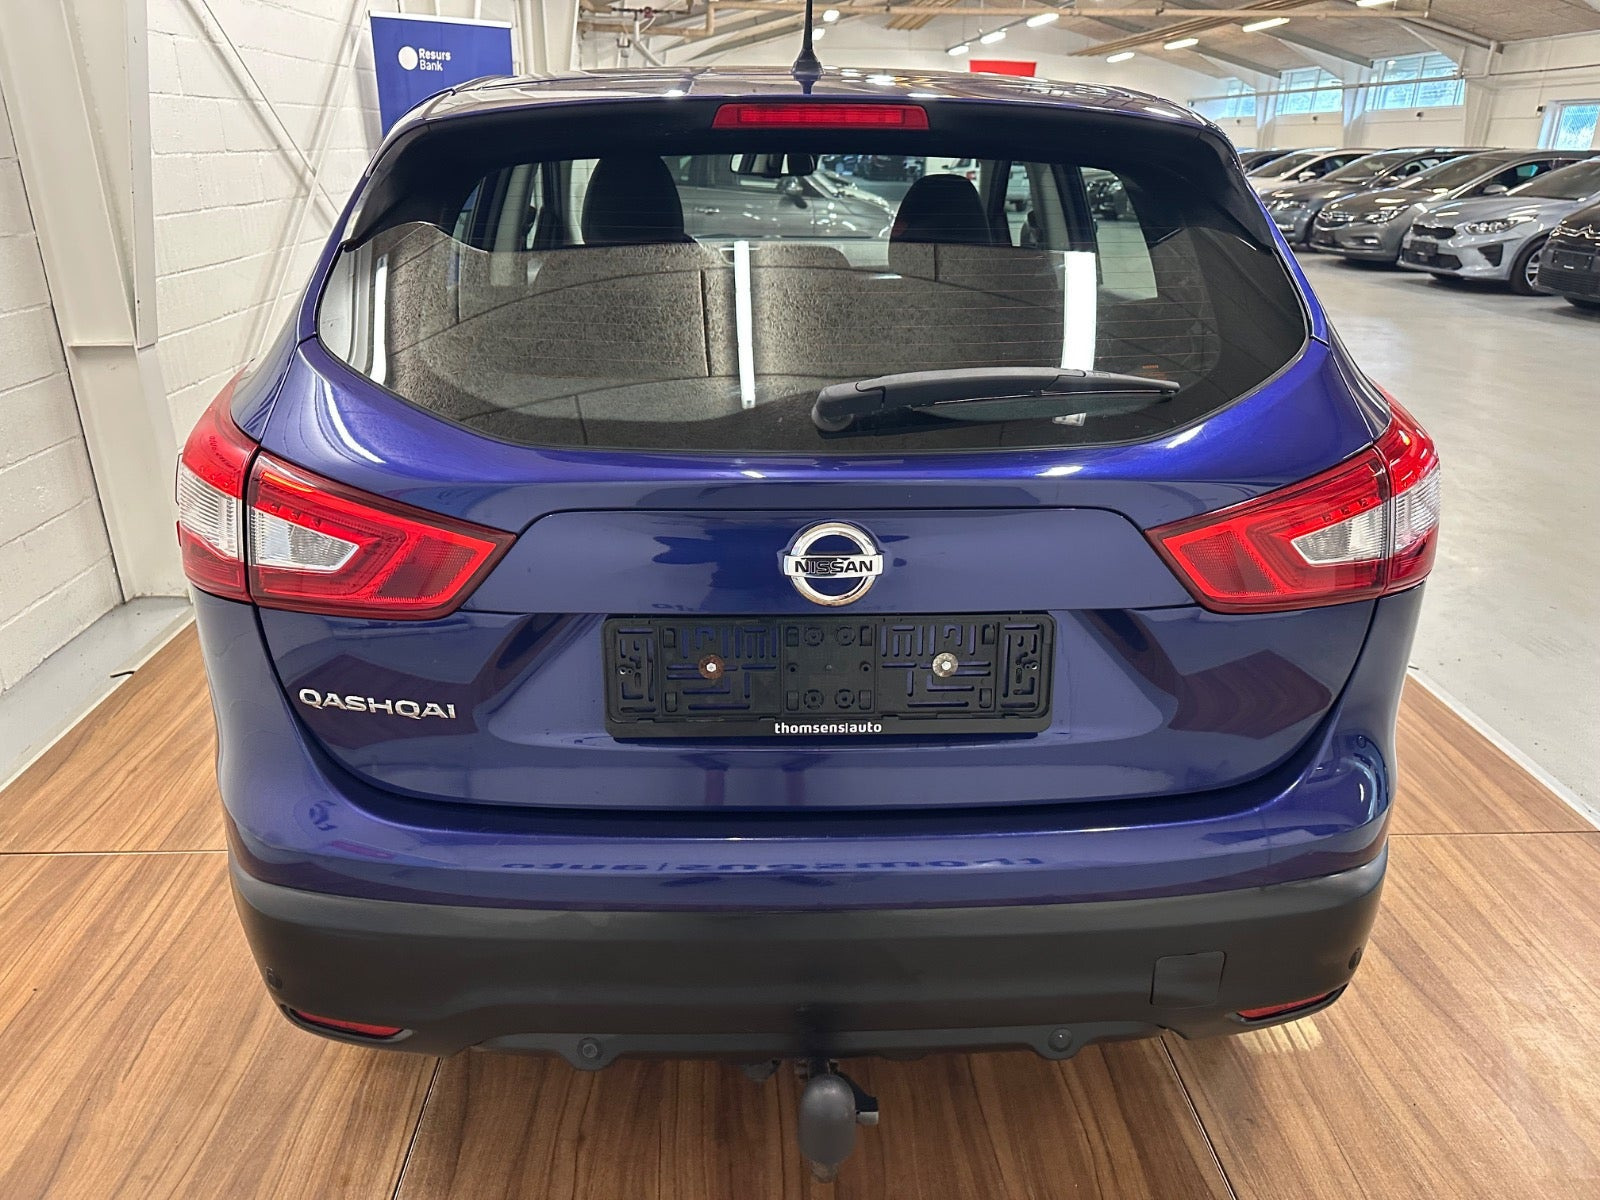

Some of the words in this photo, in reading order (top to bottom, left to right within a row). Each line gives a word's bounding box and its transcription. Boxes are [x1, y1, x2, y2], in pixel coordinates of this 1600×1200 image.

[418, 48, 451, 60] Resurs
[419, 59, 443, 71] Bank
[794, 559, 873, 574] NISSAN
[298, 688, 457, 720] QASHQAI
